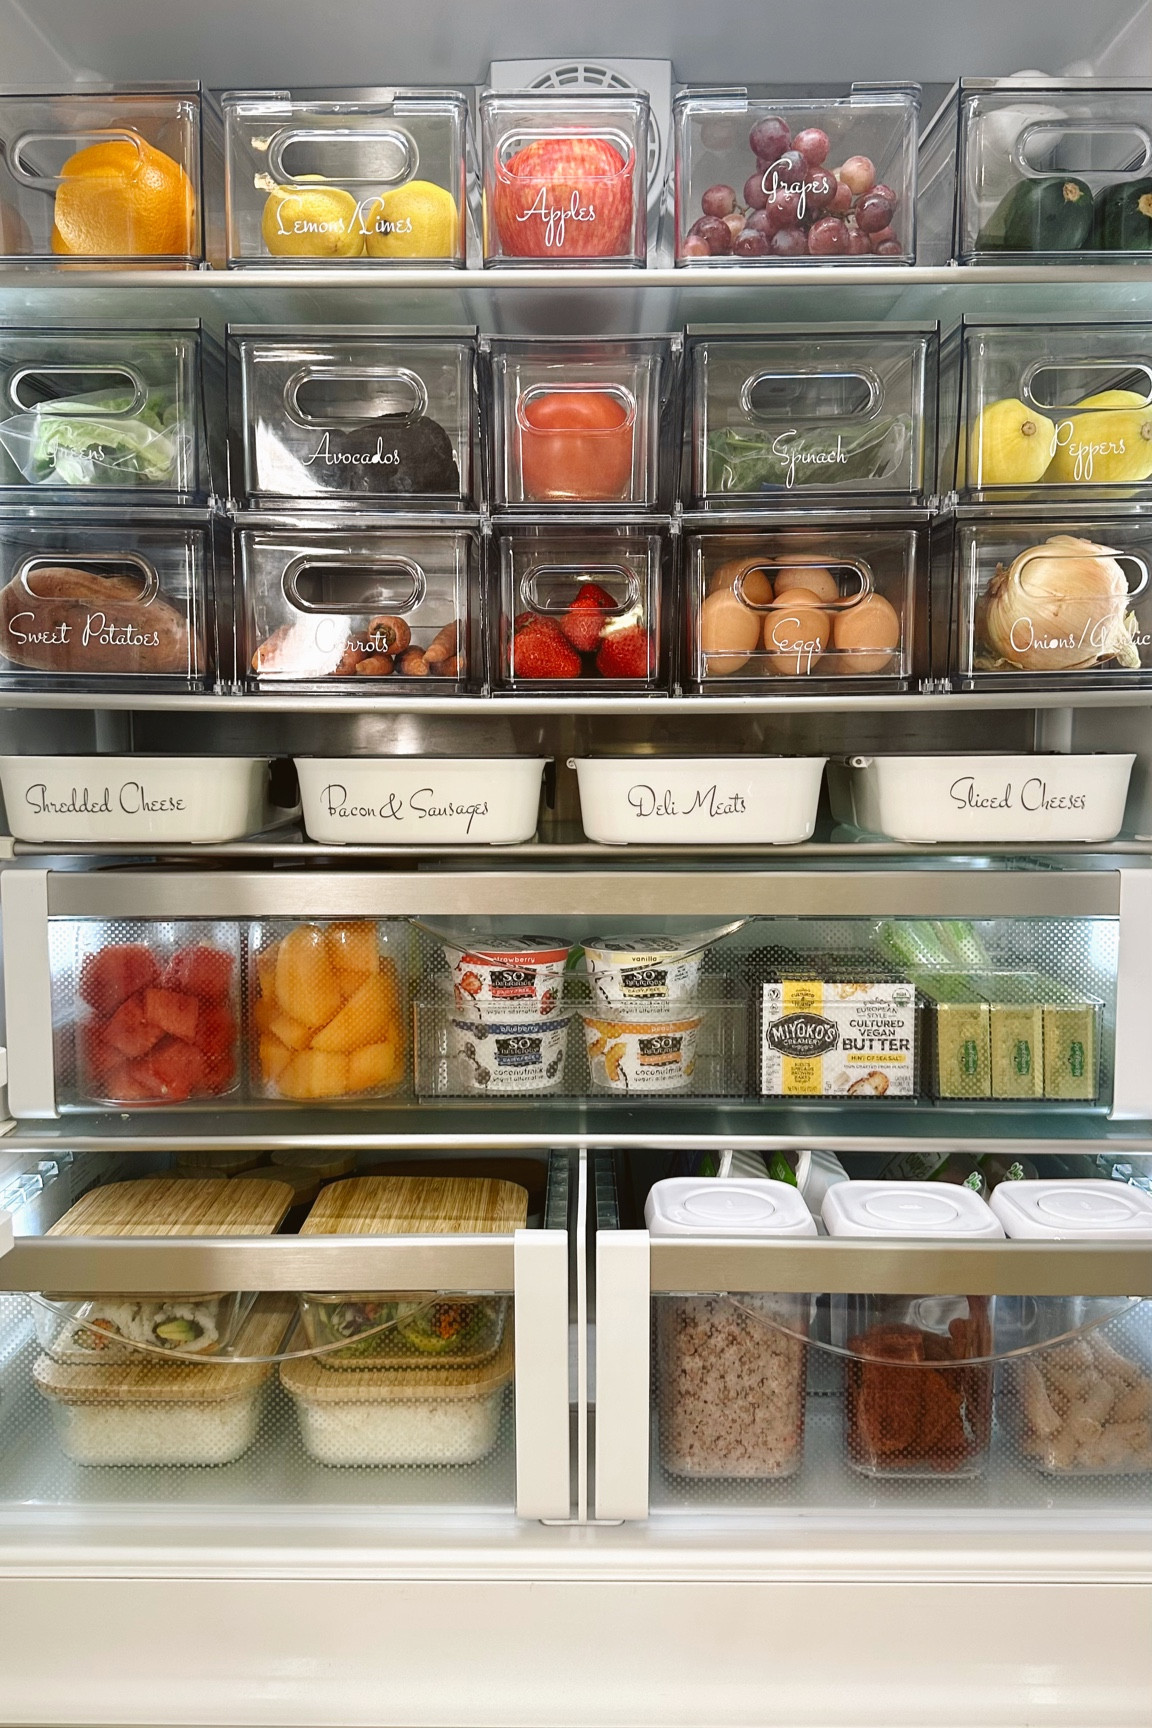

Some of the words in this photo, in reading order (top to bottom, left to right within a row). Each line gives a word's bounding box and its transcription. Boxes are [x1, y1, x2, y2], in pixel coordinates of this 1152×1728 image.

[761, 158, 829, 220] Grapes
[276, 196, 413, 235] Lemons/Limes
[515, 186, 596, 247] Apples
[301, 431, 400, 465] Avocados
[772, 429, 848, 489] Spinach
[1049, 421, 1126, 481] Peppers
[8, 611, 73, 645] Sweet
[82, 612, 160, 647] Potatoes
[315, 618, 389, 653] Crrots
[772, 617, 821, 676] Eggs
[25, 783, 113, 814] Shredded
[119, 781, 186, 814] Cheese
[319, 783, 376, 818] Bacon
[379, 792, 404, 820] &
[409, 788, 489, 835] Sausages
[627, 784, 680, 818] Deli
[681, 784, 746, 818] Meats
[949, 776, 1013, 810] Sliced
[1020, 777, 1086, 812] Cheeses
[502, 971, 525, 982] SO
[633, 970, 656, 981] SO
[849, 1019, 905, 1028] CULTURED
[856, 1006, 898, 1014] EUROPEAN
[508, 1038, 531, 1049] SO
[651, 1038, 672, 1049] SO
[842, 1038, 910, 1051] BUTTER
[859, 1028, 896, 1037] VEGAN
